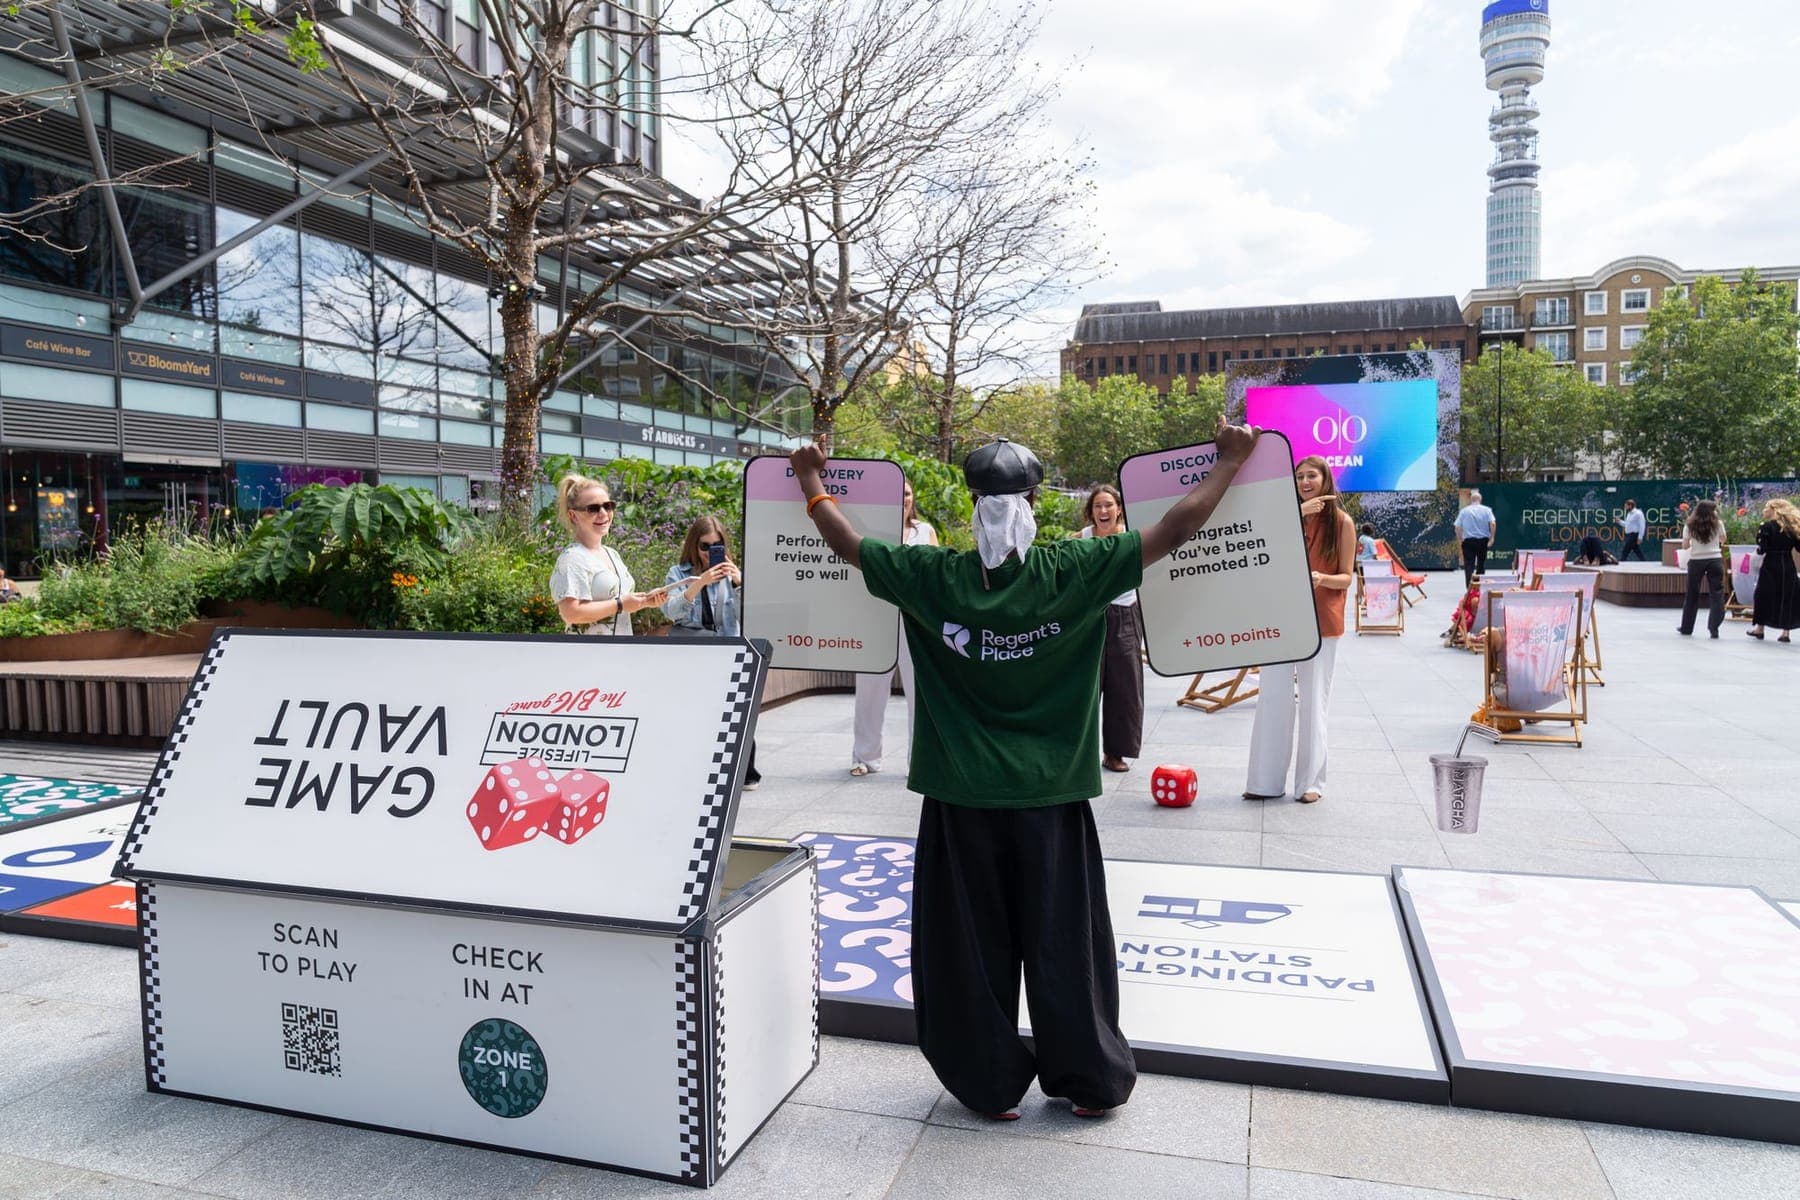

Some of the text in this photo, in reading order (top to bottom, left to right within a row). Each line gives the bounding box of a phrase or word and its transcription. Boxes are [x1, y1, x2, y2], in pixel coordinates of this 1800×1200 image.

[25, 339, 91, 357] Café Wine Bar
[148, 354, 211, 377] BloomsYard
[256, 374, 274, 384] Wine
[273, 377, 286, 386] Bar
[642, 427, 696, 448] STARBUCKS
[1160, 452, 1222, 472] DISCOV
[1321, 455, 1363, 467] CEAN
[786, 467, 864, 480] DOVERY
[1522, 508, 1606, 525] REGENT'S
[776, 534, 826, 548] Perfor
[1646, 526, 1684, 541] FRO
[774, 551, 823, 563] review
[1169, 538, 1266, 561] You've been
[795, 569, 848, 581] go well
[1169, 553, 1270, 581] promoted :D
[787, 635, 813, 647] 100
[818, 637, 863, 650] points
[981, 622, 1061, 649] Regent's
[1196, 633, 1225, 648] 100
[1231, 627, 1281, 646] points
[981, 646, 1034, 661] Place
[502, 688, 627, 717] The BIG game!
[253, 699, 448, 756] VAULT
[496, 721, 626, 748] LONDON
[518, 747, 590, 763] LIFESIZE
[244, 757, 435, 818] GAME
[1452, 769, 1465, 830] MATCHA
[273, 922, 338, 949] SCAN
[452, 943, 544, 973] CHECK
[1120, 942, 1313, 967] STATION
[258, 951, 357, 982] TO PLAY
[1116, 960, 1375, 992] PADDINGT
[464, 977, 533, 1005] IN AT
[473, 1046, 532, 1071] ZONE
[498, 1071, 507, 1088] 1
